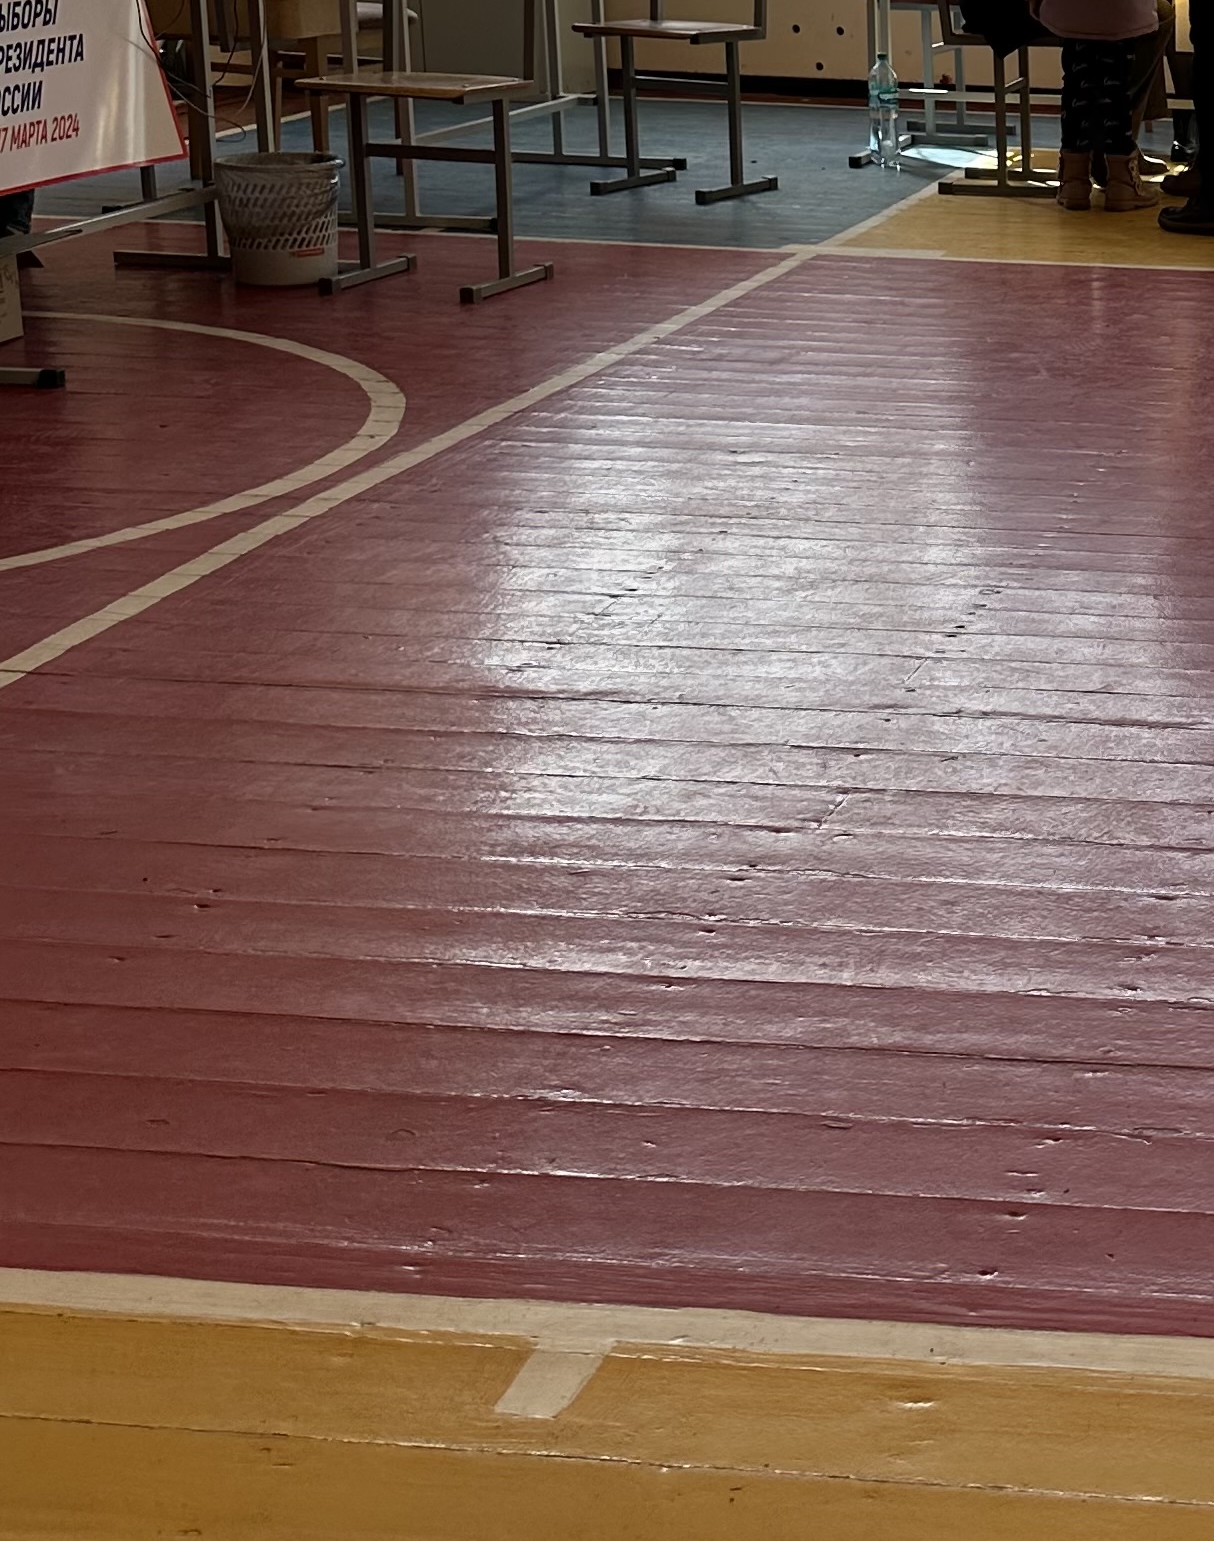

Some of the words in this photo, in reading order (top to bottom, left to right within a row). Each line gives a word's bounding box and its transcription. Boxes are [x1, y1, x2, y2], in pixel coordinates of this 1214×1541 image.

[0, 80, 43, 117] ССИИ
[10, 118, 48, 152] МАРТА
[50, 113, 80, 143] 2024
